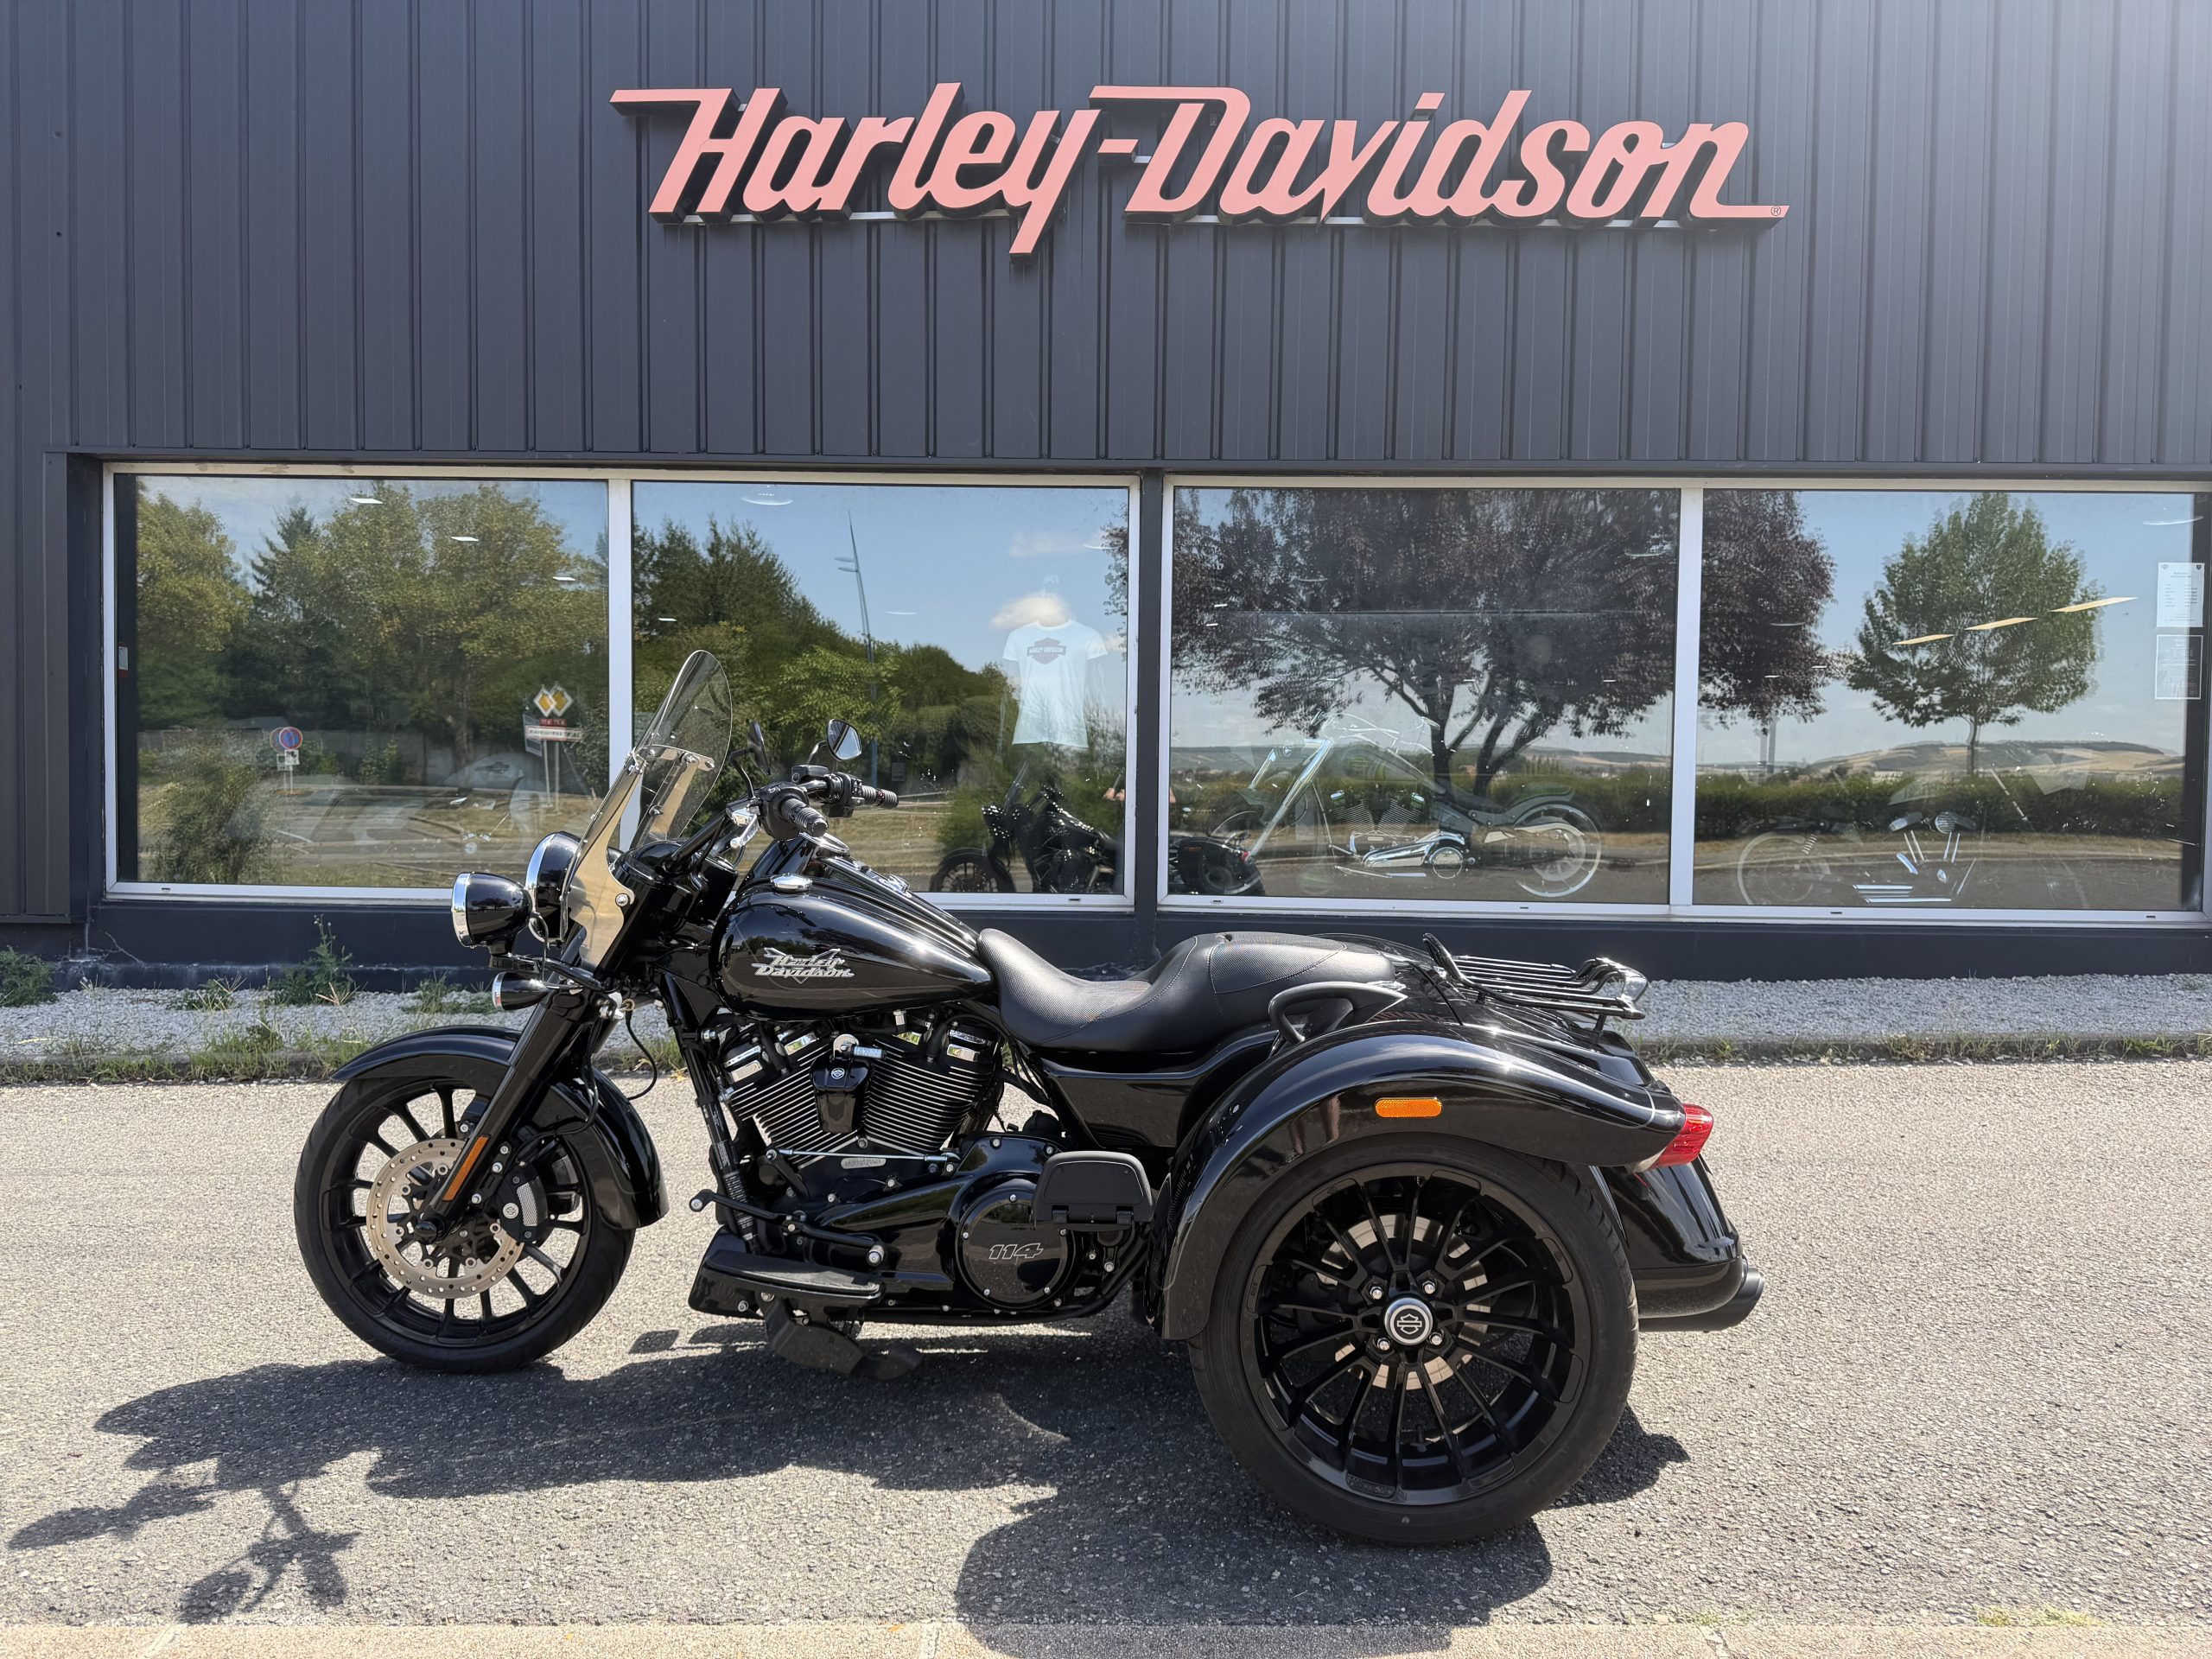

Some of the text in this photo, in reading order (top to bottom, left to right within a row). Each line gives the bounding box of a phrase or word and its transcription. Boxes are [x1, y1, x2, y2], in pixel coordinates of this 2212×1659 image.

[610, 82, 1790, 257] Harley-Davidson
[764, 950, 845, 969] Harley
[752, 963, 855, 977] Davidson
[988, 1243, 1044, 1260] 114
